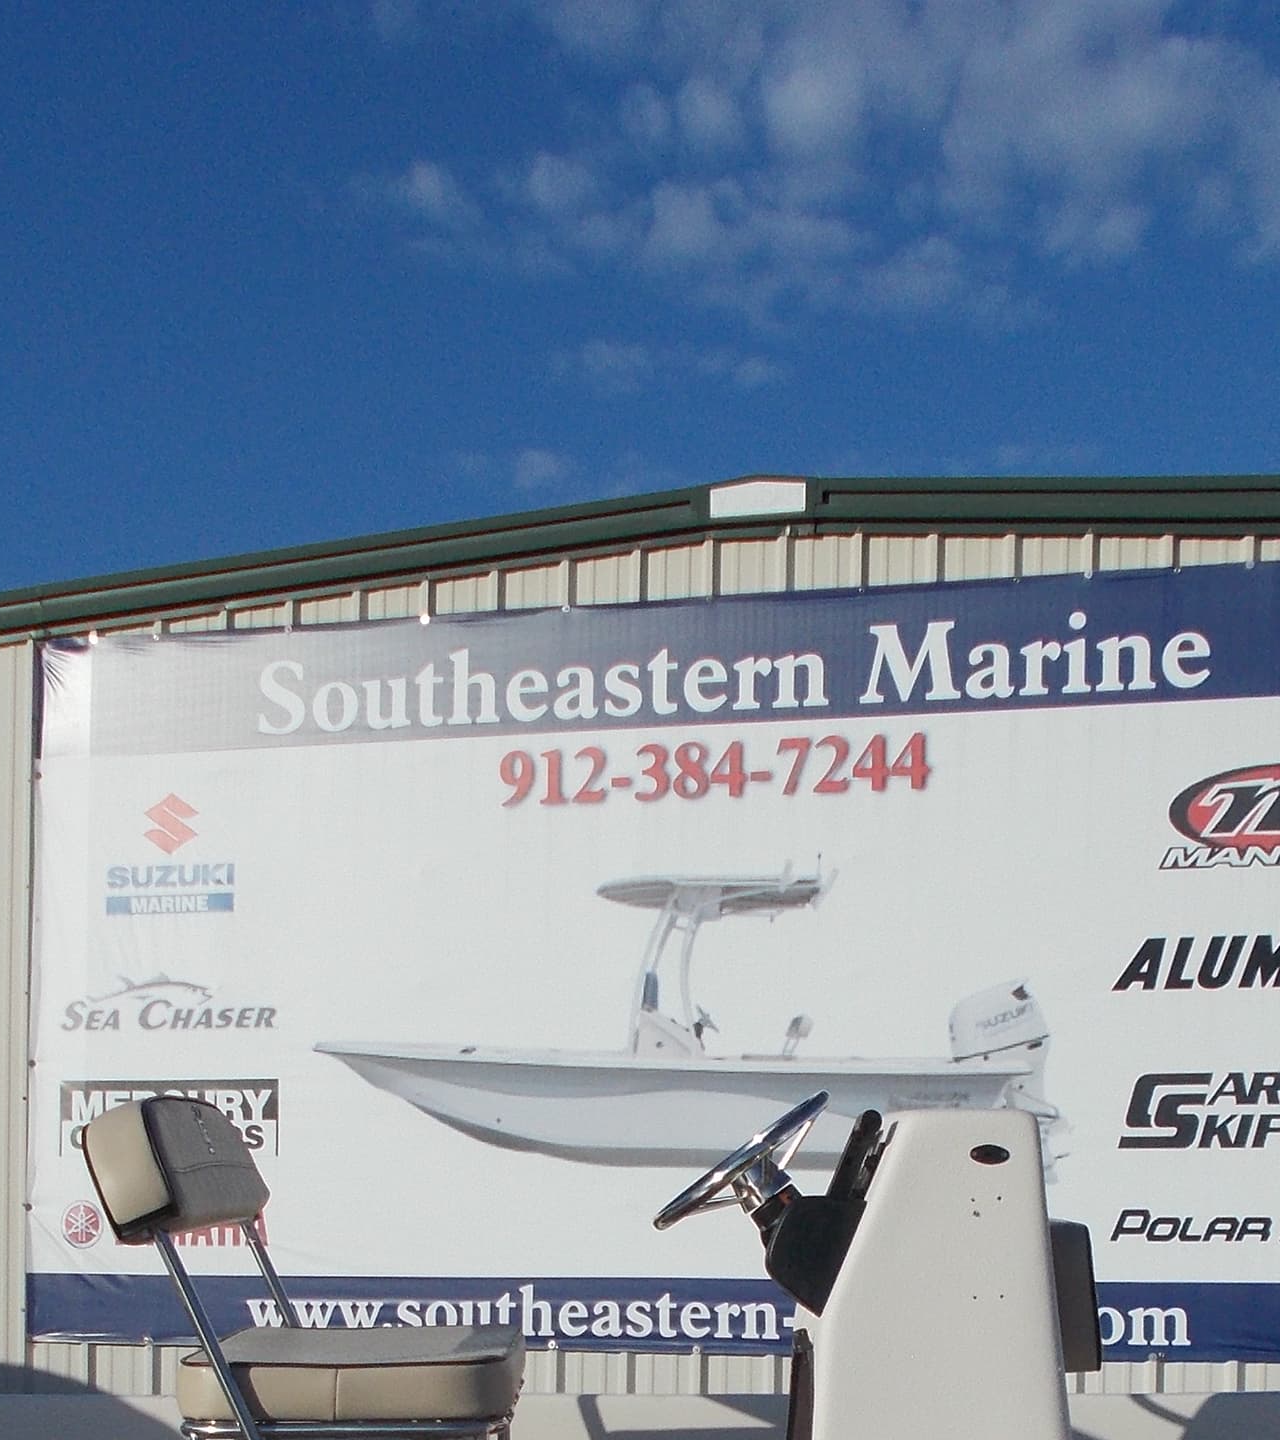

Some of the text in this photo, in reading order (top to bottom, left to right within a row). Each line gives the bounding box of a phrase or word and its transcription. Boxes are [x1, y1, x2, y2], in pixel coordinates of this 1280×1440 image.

[257, 611, 1212, 736] Southeastern Marine
[499, 731, 932, 808] 912-384-7244
[107, 863, 235, 888] SUZUKI
[131, 894, 209, 915] MARINE
[60, 998, 277, 1032] SEA CHASER
[1110, 1208, 1273, 1243] POLAR
